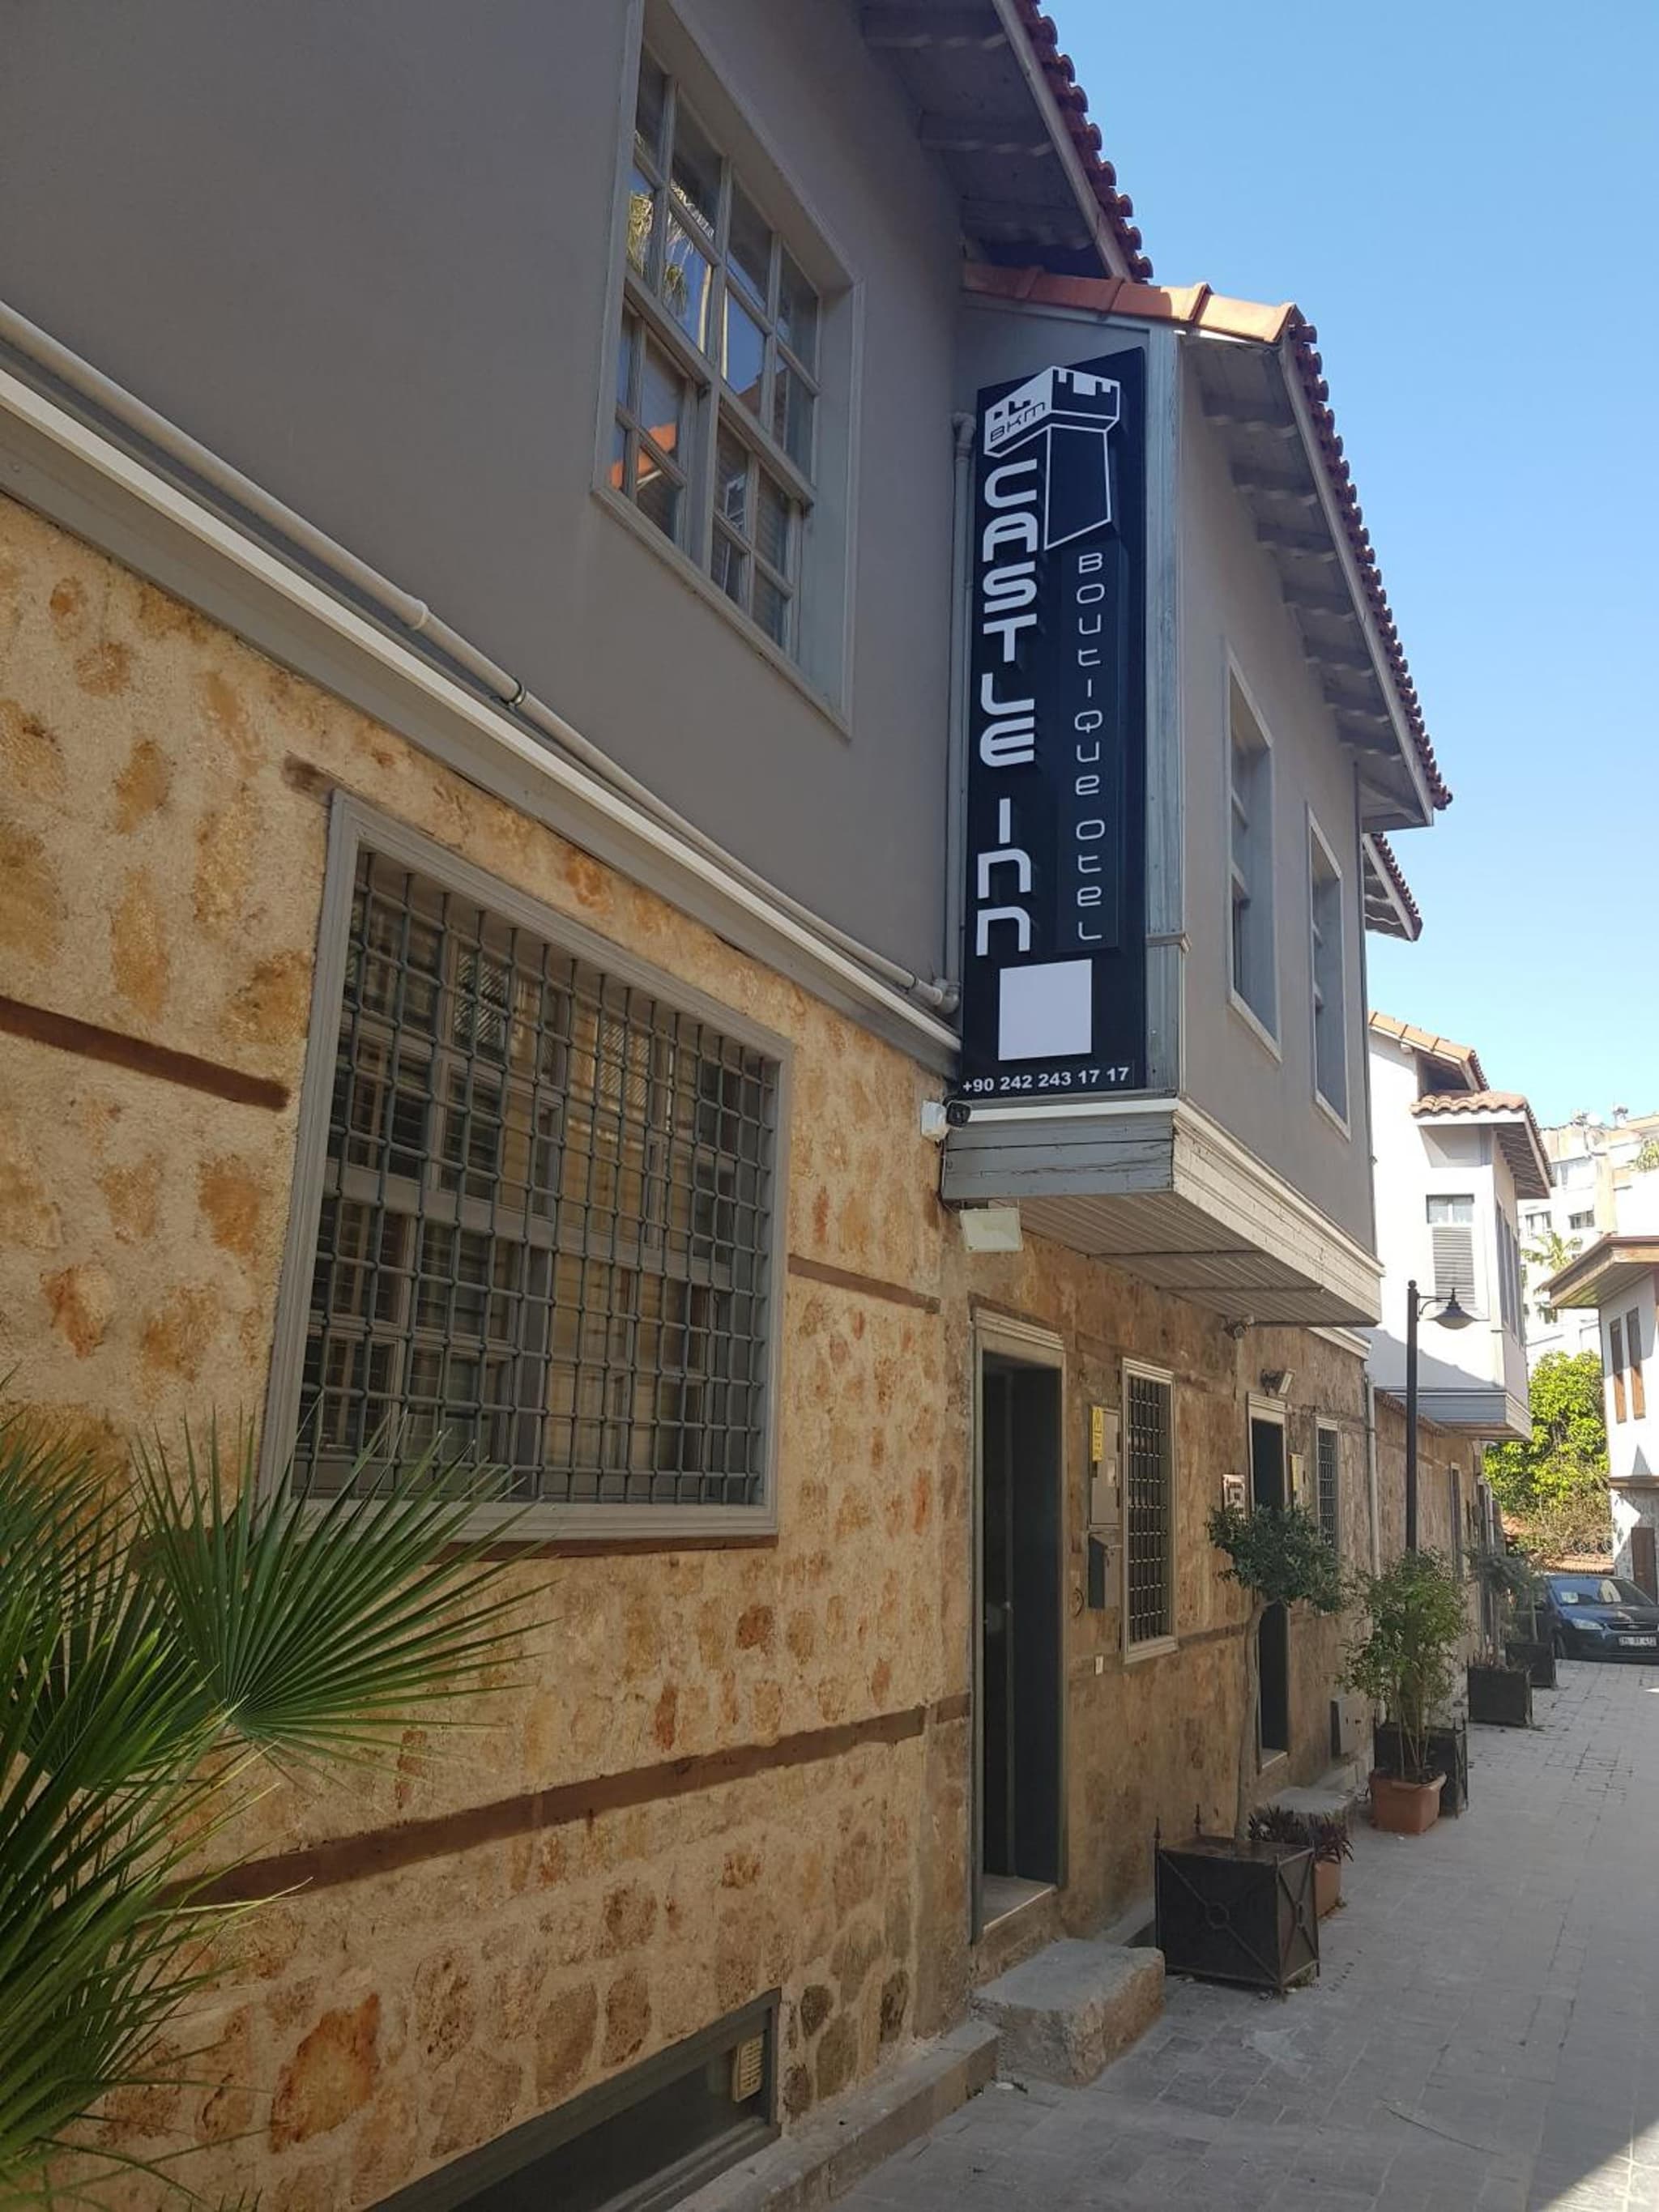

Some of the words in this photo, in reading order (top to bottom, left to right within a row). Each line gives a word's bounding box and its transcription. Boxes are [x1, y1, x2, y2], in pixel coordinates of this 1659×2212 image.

[962, 1077, 995, 1093] +90
[999, 1075, 1033, 1091] 242
[1038, 1072, 1072, 1088] 243
[1078, 1069, 1101, 1085] 17
[1107, 1067, 1130, 1082] 17
